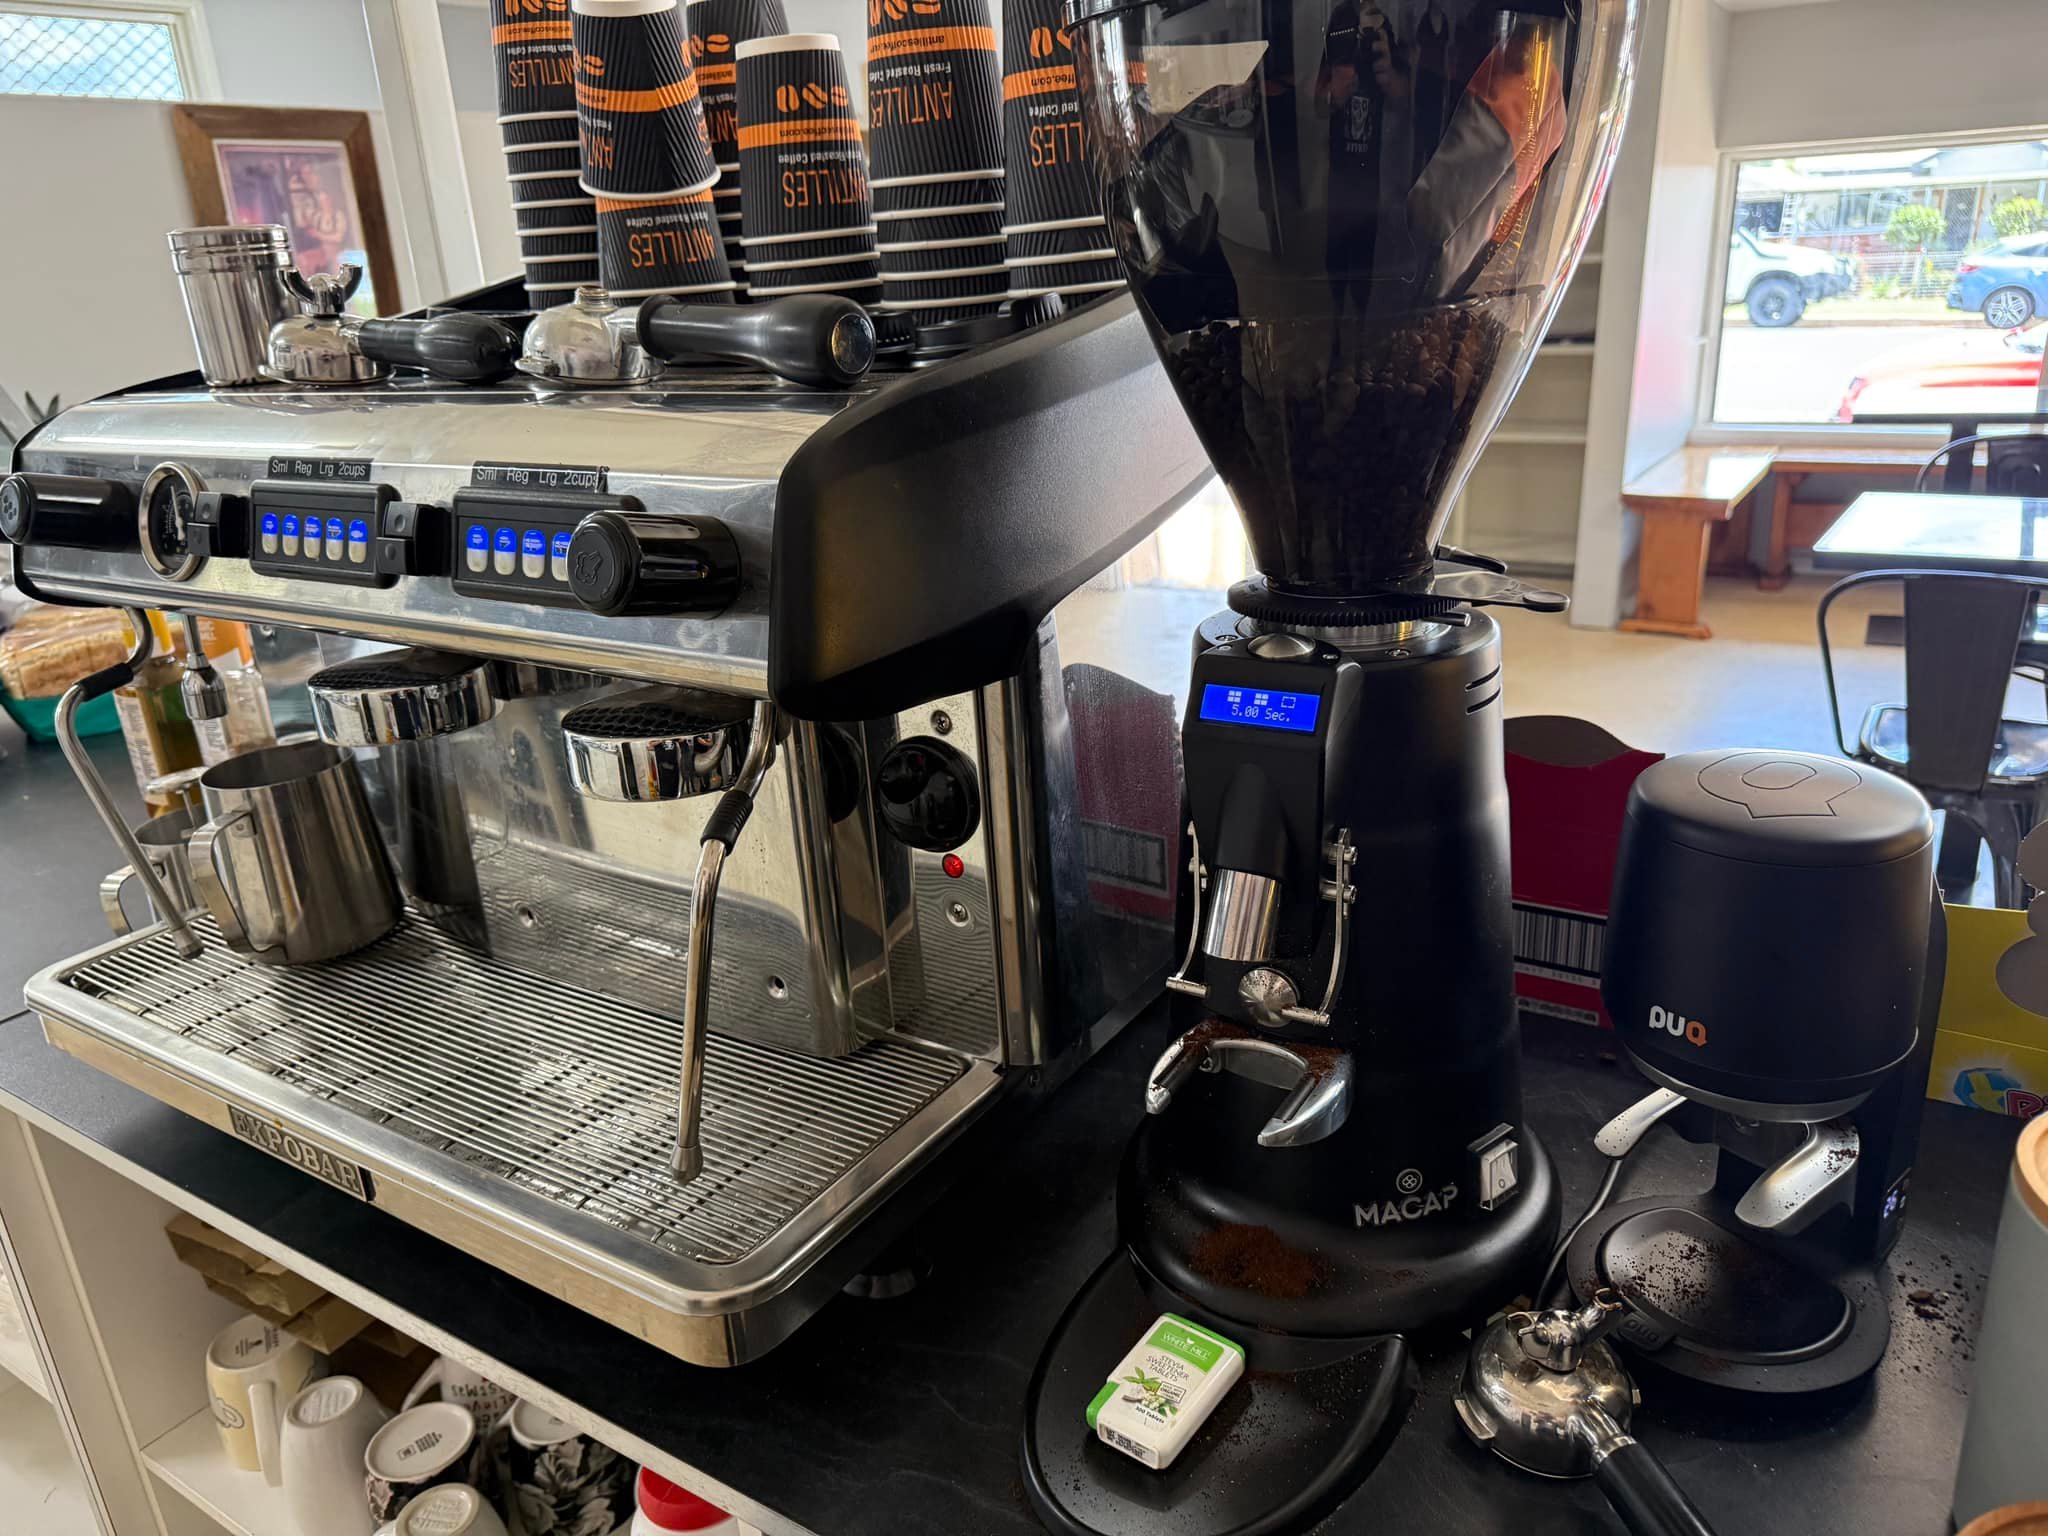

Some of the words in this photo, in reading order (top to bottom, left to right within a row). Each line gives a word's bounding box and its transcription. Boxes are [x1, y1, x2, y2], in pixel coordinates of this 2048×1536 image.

[886, 65, 921, 80] Roasted
[924, 61, 952, 75] Fresh
[870, 81, 953, 129] ANTILLES
[778, 153, 809, 165] Coffee
[626, 215, 654, 228] Coffee
[628, 230, 715, 269] ANTILLES
[271, 459, 289, 473] Sml
[295, 460, 313, 477] Reg
[319, 459, 335, 477] Lrg
[338, 461, 367, 478] 2cups
[476, 466, 497, 481] Sml
[506, 468, 529, 485] Reg
[539, 469, 558, 487] Lrg
[1231, 704, 1259, 718] 5.00
[1264, 708, 1291, 723] Sec.
[235, 1111, 361, 1193] EXPOBAR
[1354, 1184, 1458, 1227] MACAP
